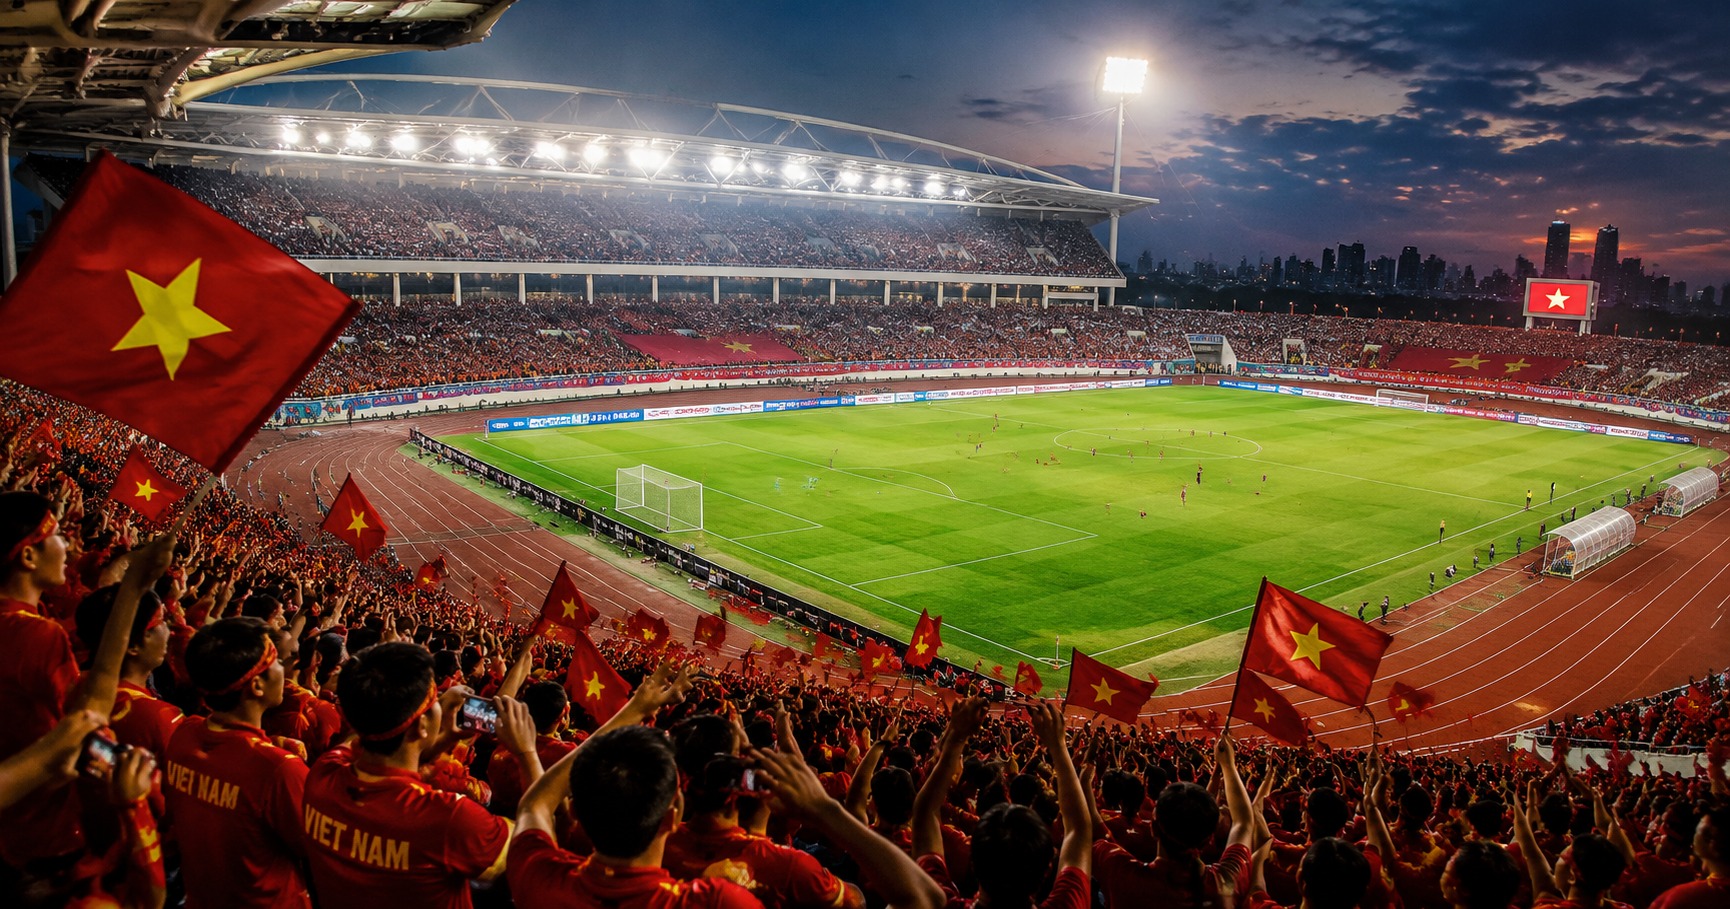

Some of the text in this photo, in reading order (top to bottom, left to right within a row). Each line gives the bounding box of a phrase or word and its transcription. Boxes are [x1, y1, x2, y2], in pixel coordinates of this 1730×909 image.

[197, 773, 240, 810] NAM
[305, 803, 410, 870] VIET NAM
